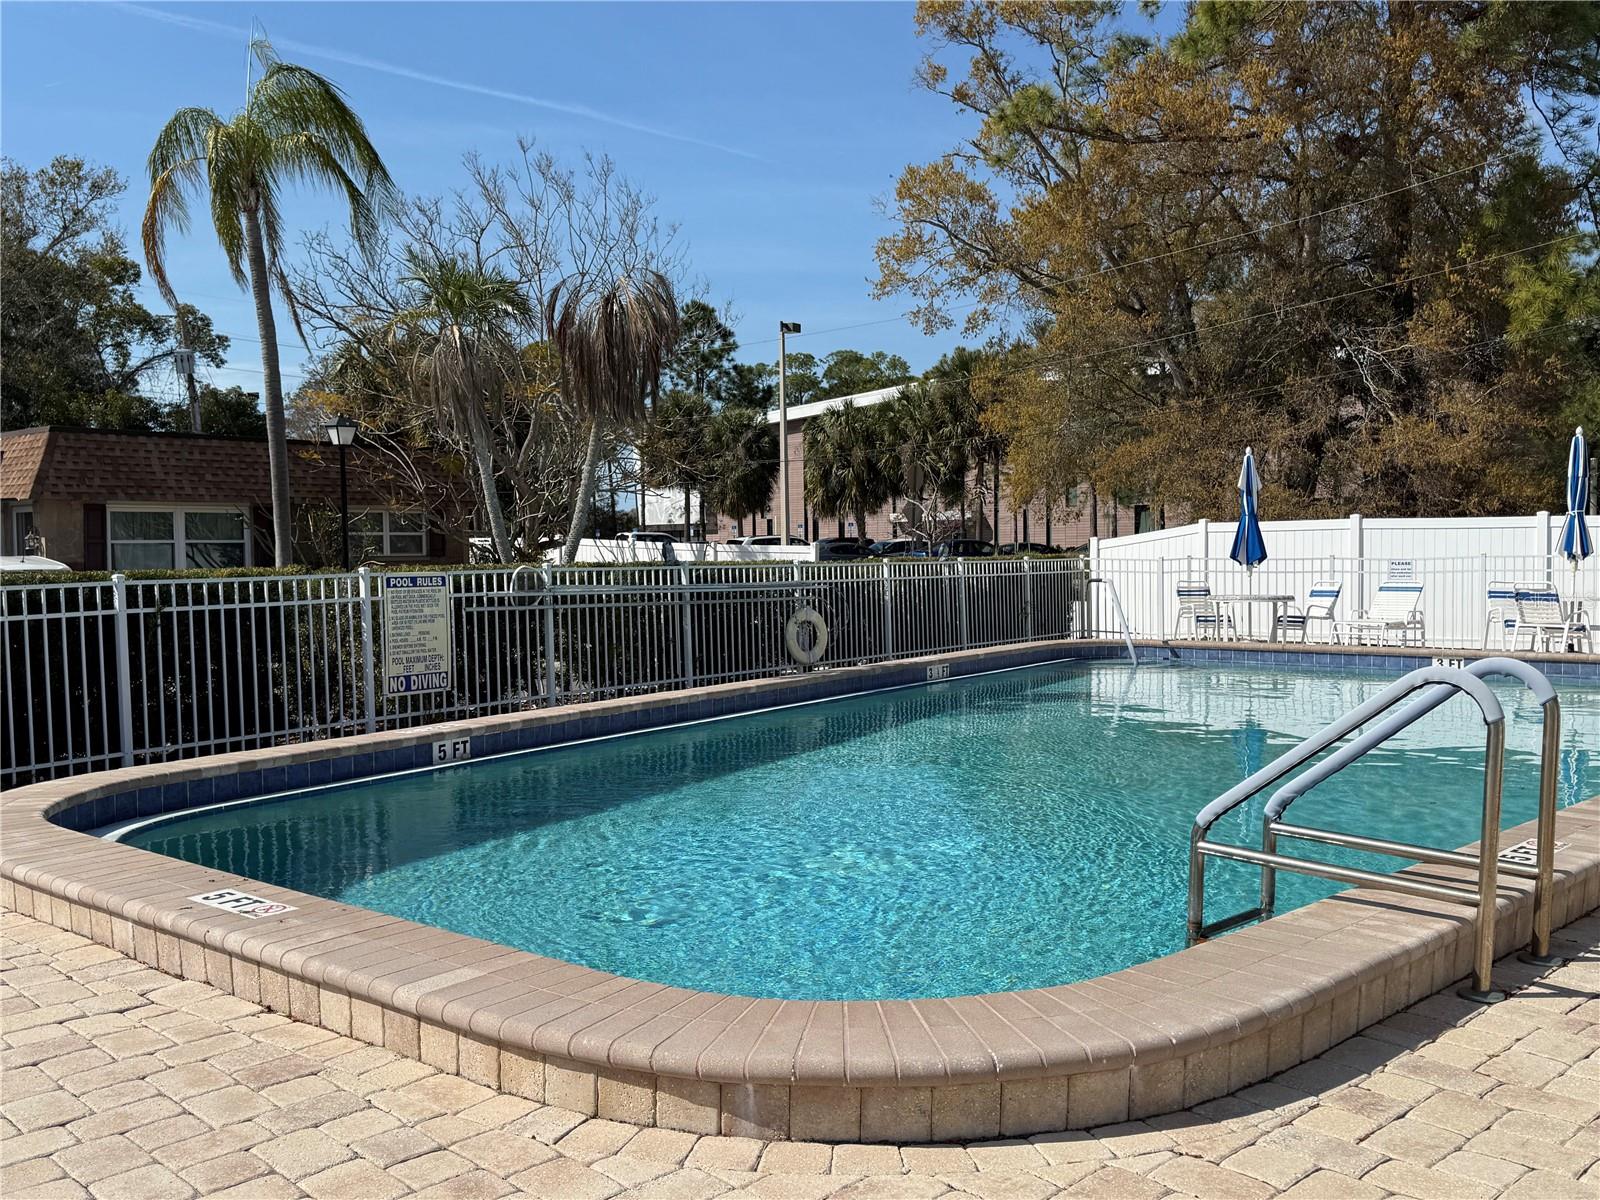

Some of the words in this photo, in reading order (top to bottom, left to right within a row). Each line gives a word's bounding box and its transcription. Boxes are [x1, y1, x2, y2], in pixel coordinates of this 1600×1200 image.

[390, 578, 413, 587] POOL
[417, 577, 443, 586] RULES
[392, 656, 404, 666] POOL
[406, 655, 428, 664] MAXIMUM
[1449, 658, 1463, 670] FT
[403, 664, 415, 673] FEET
[424, 663, 441, 671] INCHES
[928, 667, 933, 679] 3
[942, 665, 949, 678] FT
[389, 677, 406, 693] NO
[410, 672, 447, 691] DIVING
[438, 743, 447, 761] 5
[452, 739, 469, 759] FT
[202, 891, 236, 900] 5
[218, 896, 266, 908] FT
